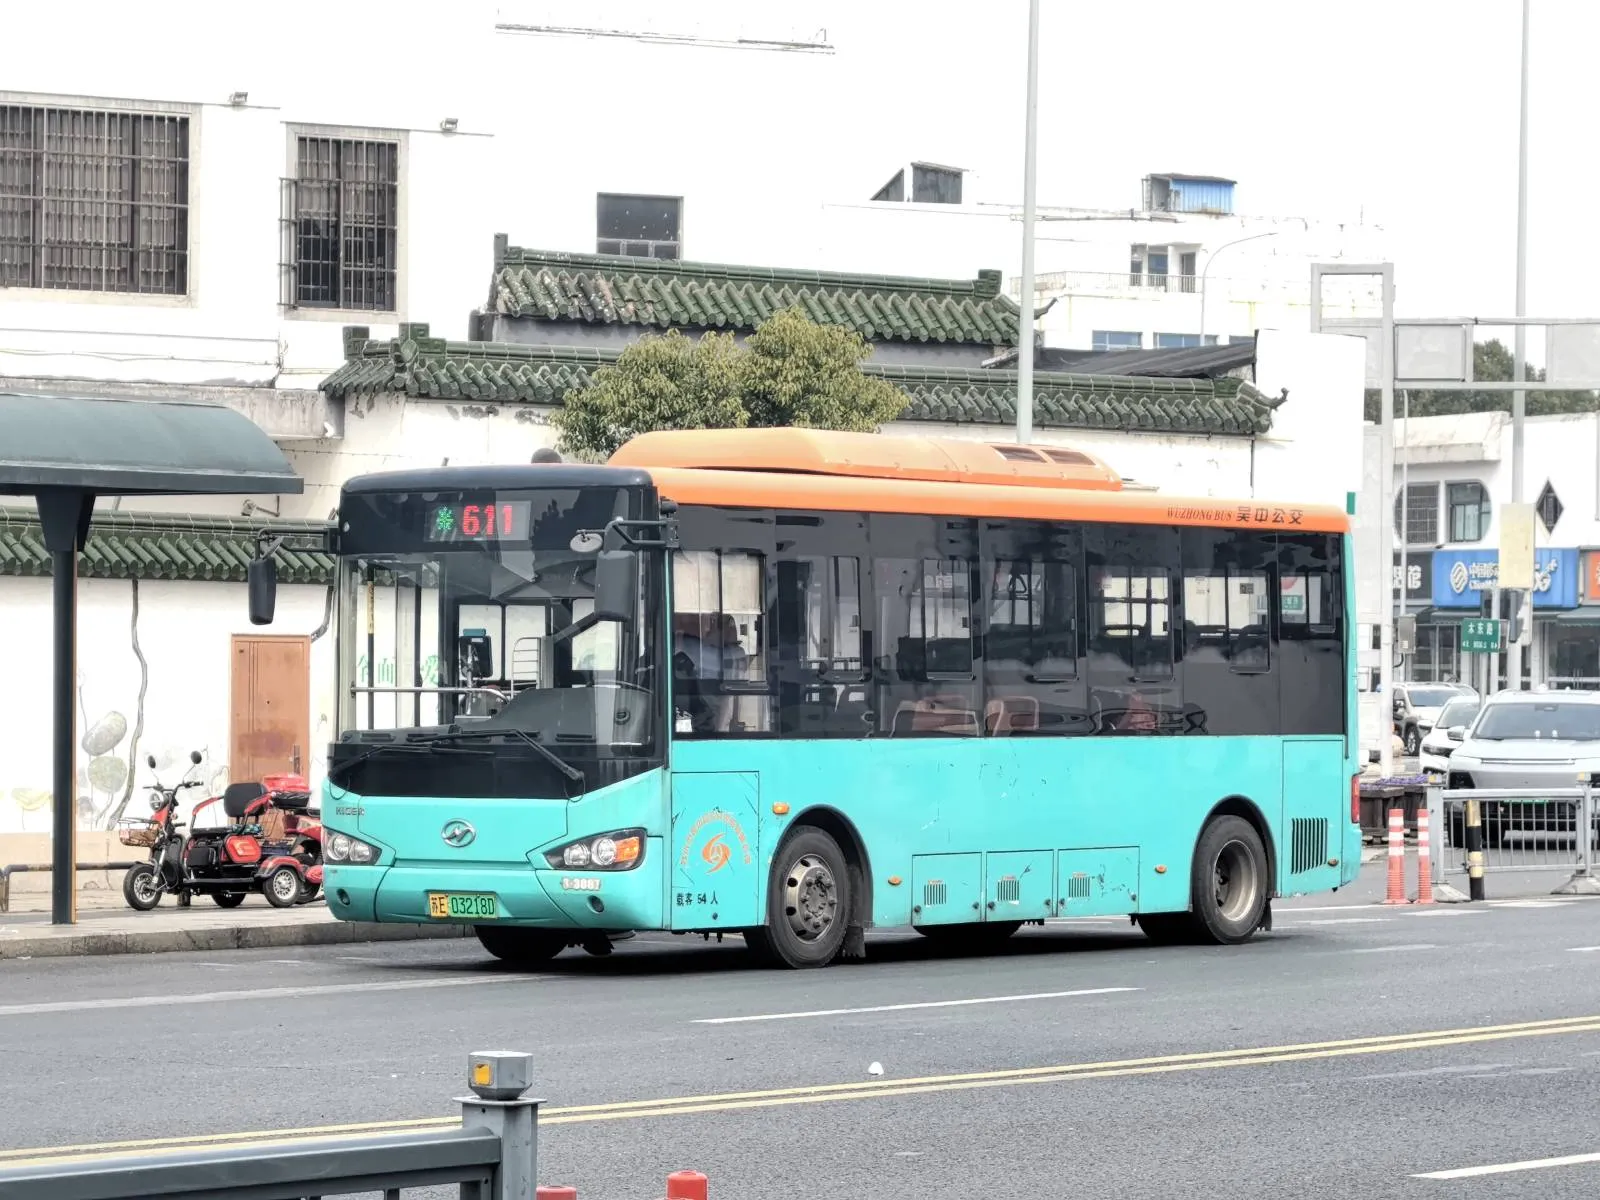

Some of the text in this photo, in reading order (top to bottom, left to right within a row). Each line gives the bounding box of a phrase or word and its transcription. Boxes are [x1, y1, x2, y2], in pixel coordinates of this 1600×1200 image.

[463, 505, 513, 535] 611
[1167, 505, 1232, 521] WUZHONG BUS
[1236, 506, 1303, 525] 吴中公交
